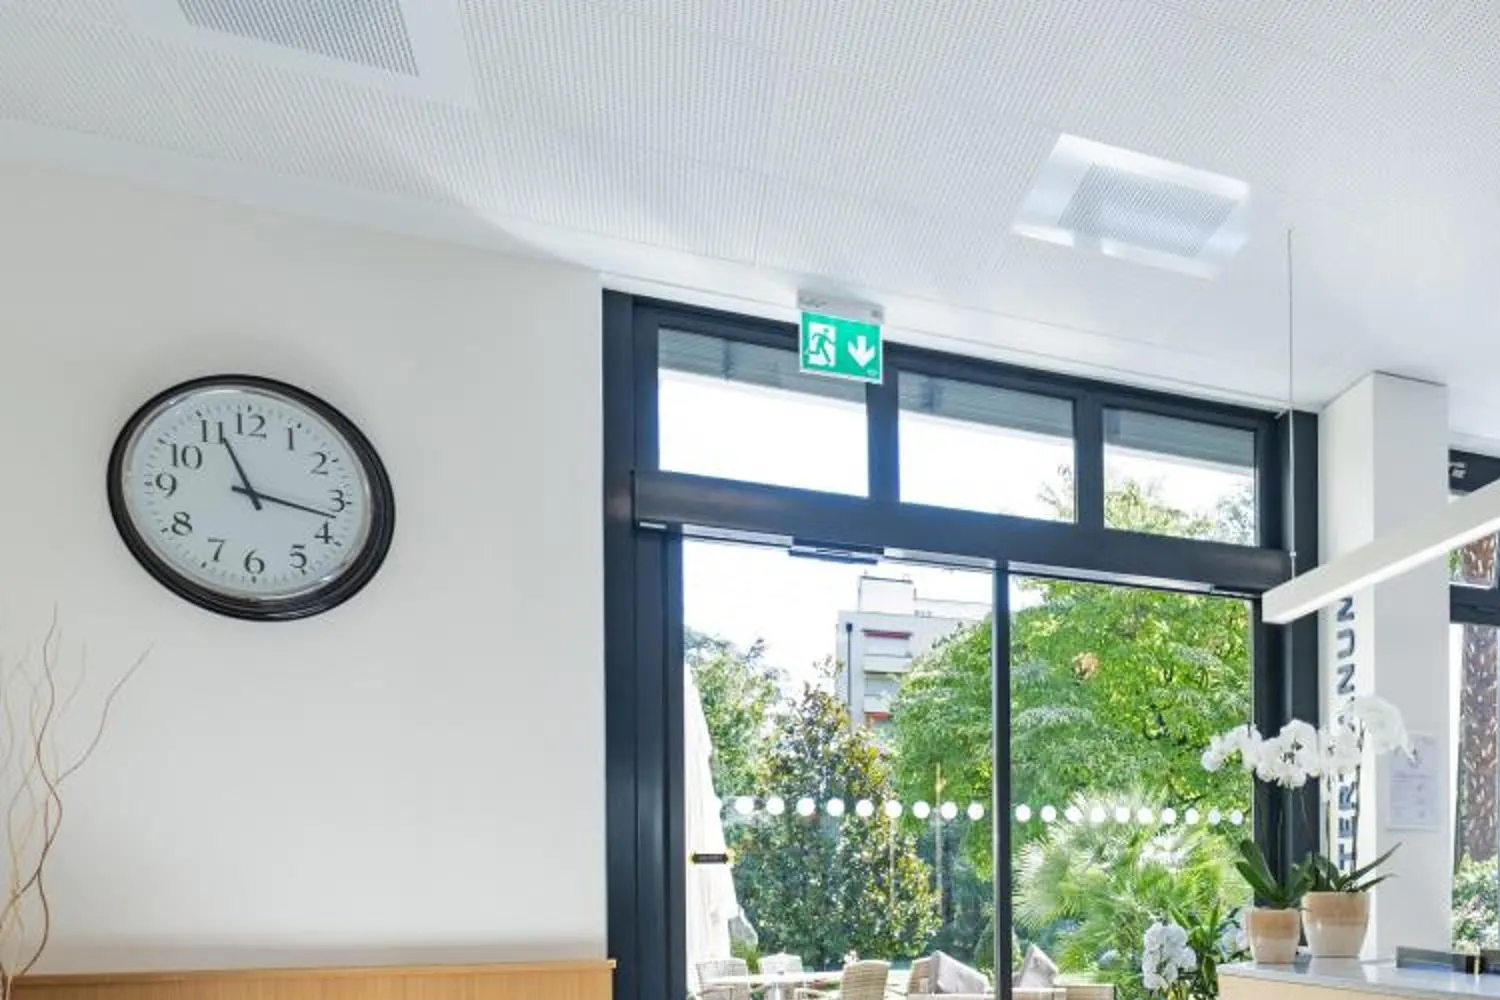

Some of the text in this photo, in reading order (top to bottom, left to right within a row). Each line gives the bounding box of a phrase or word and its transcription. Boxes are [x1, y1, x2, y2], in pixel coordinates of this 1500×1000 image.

[200, 419, 226, 444] 11
[236, 412, 267, 438] 12
[171, 443, 202, 470] 10
[311, 452, 328, 475] 2
[155, 472, 177, 498] 9
[328, 490, 345, 512] 3
[171, 512, 192, 536] 8
[314, 522, 333, 544] 4
[207, 538, 226, 562] 7
[244, 549, 264, 574] 6
[289, 544, 307, 569] 5
